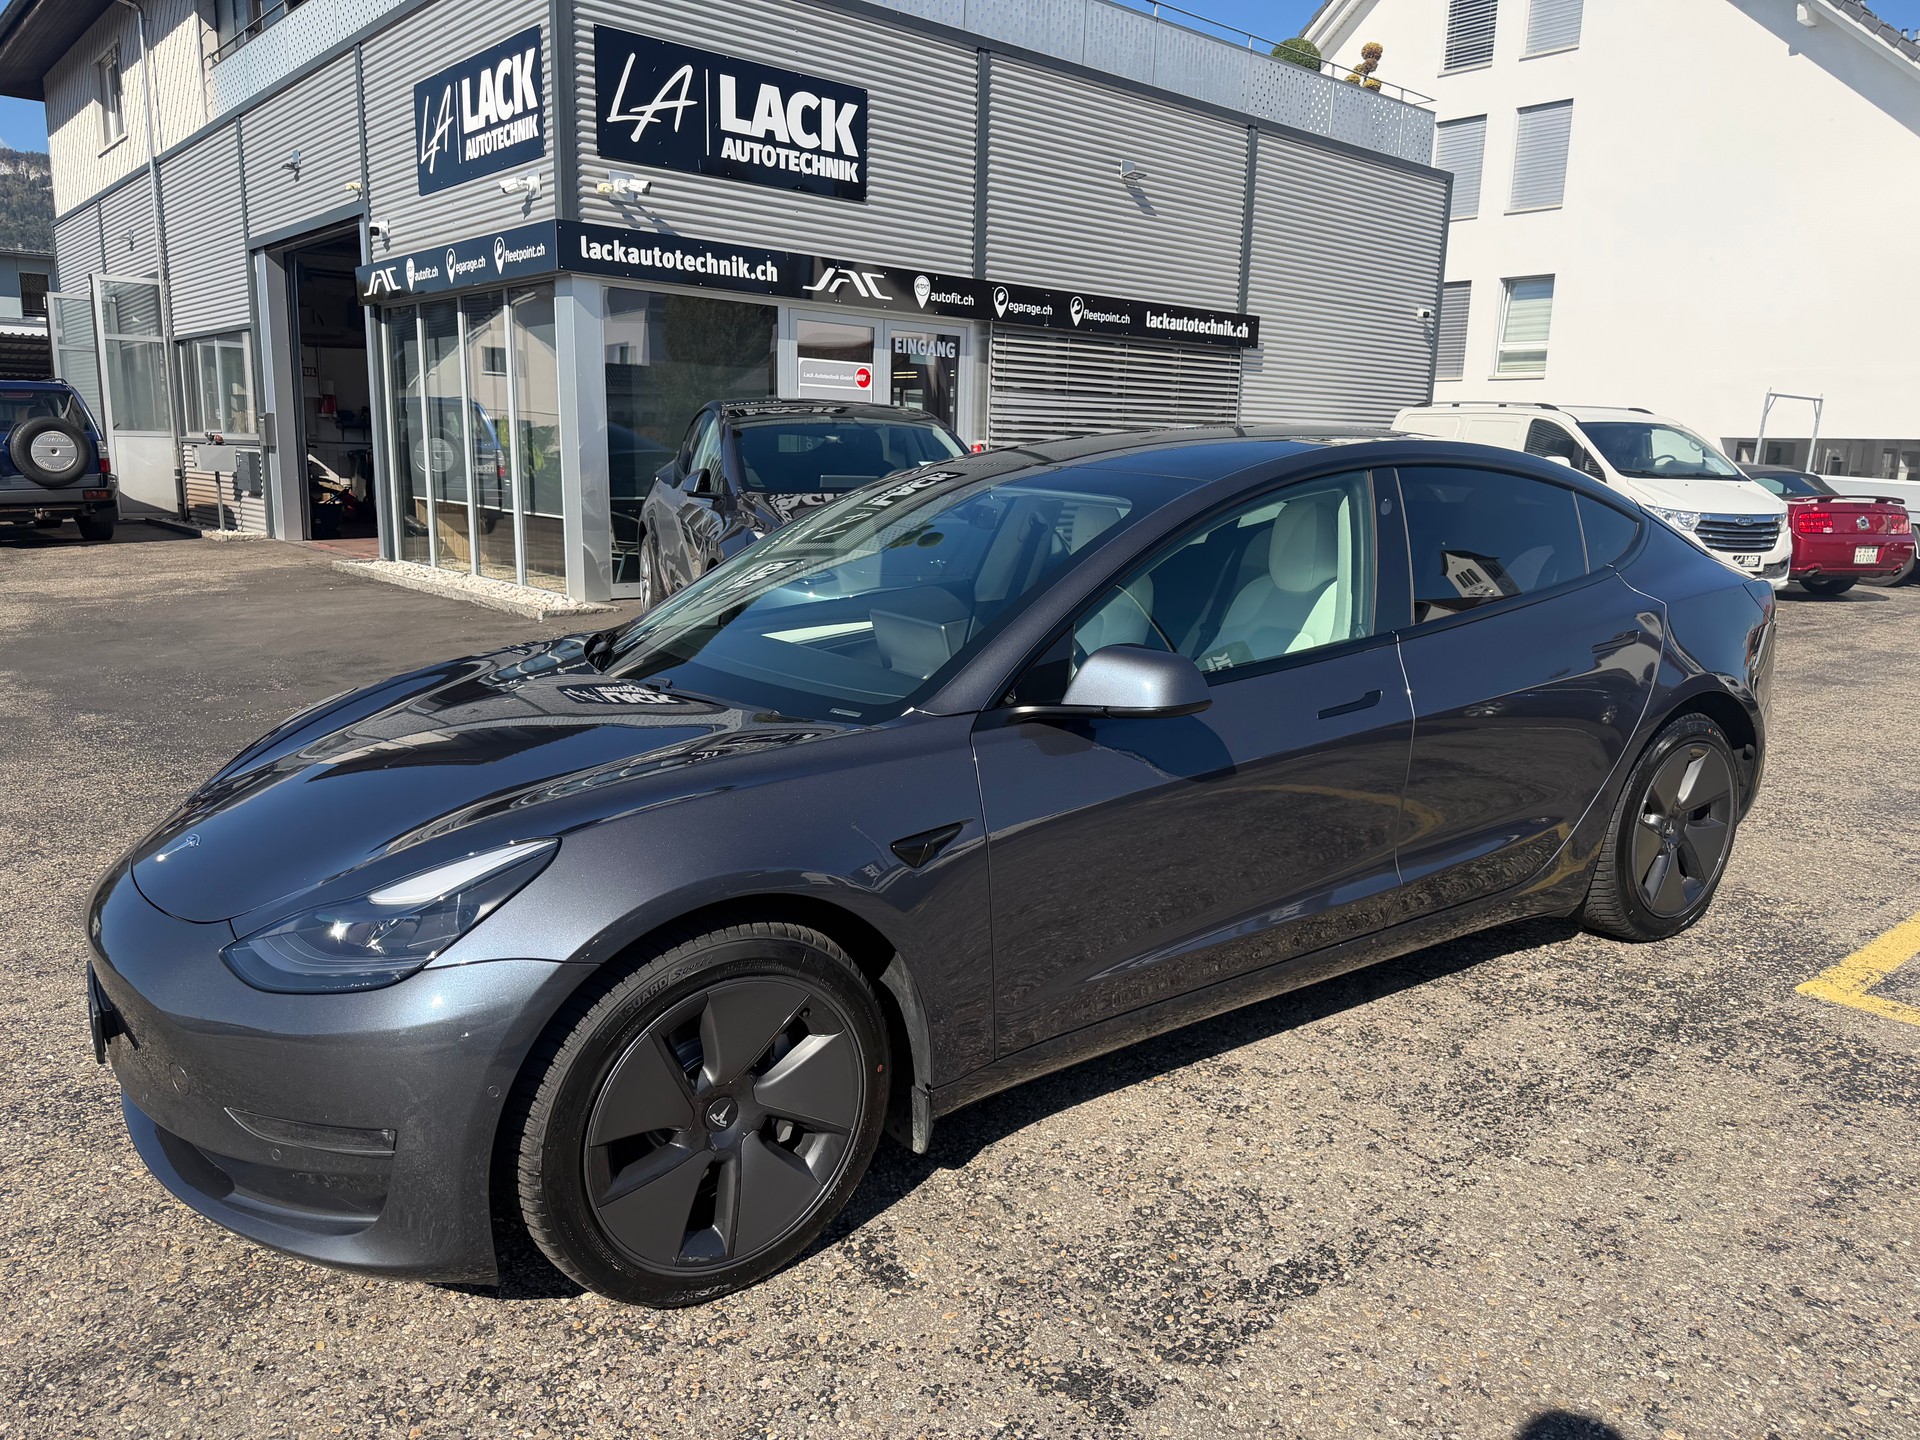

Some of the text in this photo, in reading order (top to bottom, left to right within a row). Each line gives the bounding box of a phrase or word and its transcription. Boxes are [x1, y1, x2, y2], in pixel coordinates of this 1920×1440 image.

[461, 47, 538, 134] LACK
[606, 52, 698, 142] LA
[420, 84, 454, 174] LA
[719, 73, 859, 158] LACK
[465, 113, 539, 161] AUTOTECHNIK
[720, 137, 859, 183] AUTOTECHNIK
[455, 255, 486, 275] egarage.ch
[505, 243, 546, 263] fleetpoint.ch
[580, 235, 778, 282] lackautotechnik.ch
[414, 265, 439, 282] autofit.ch
[930, 291, 975, 306] autofit.ch
[1008, 301, 1053, 316] egarage.ch
[1083, 310, 1131, 325] fleetpoint.ch
[1145, 310, 1249, 339] lackautotechnik.ch
[895, 337, 956, 358] EINGANG
